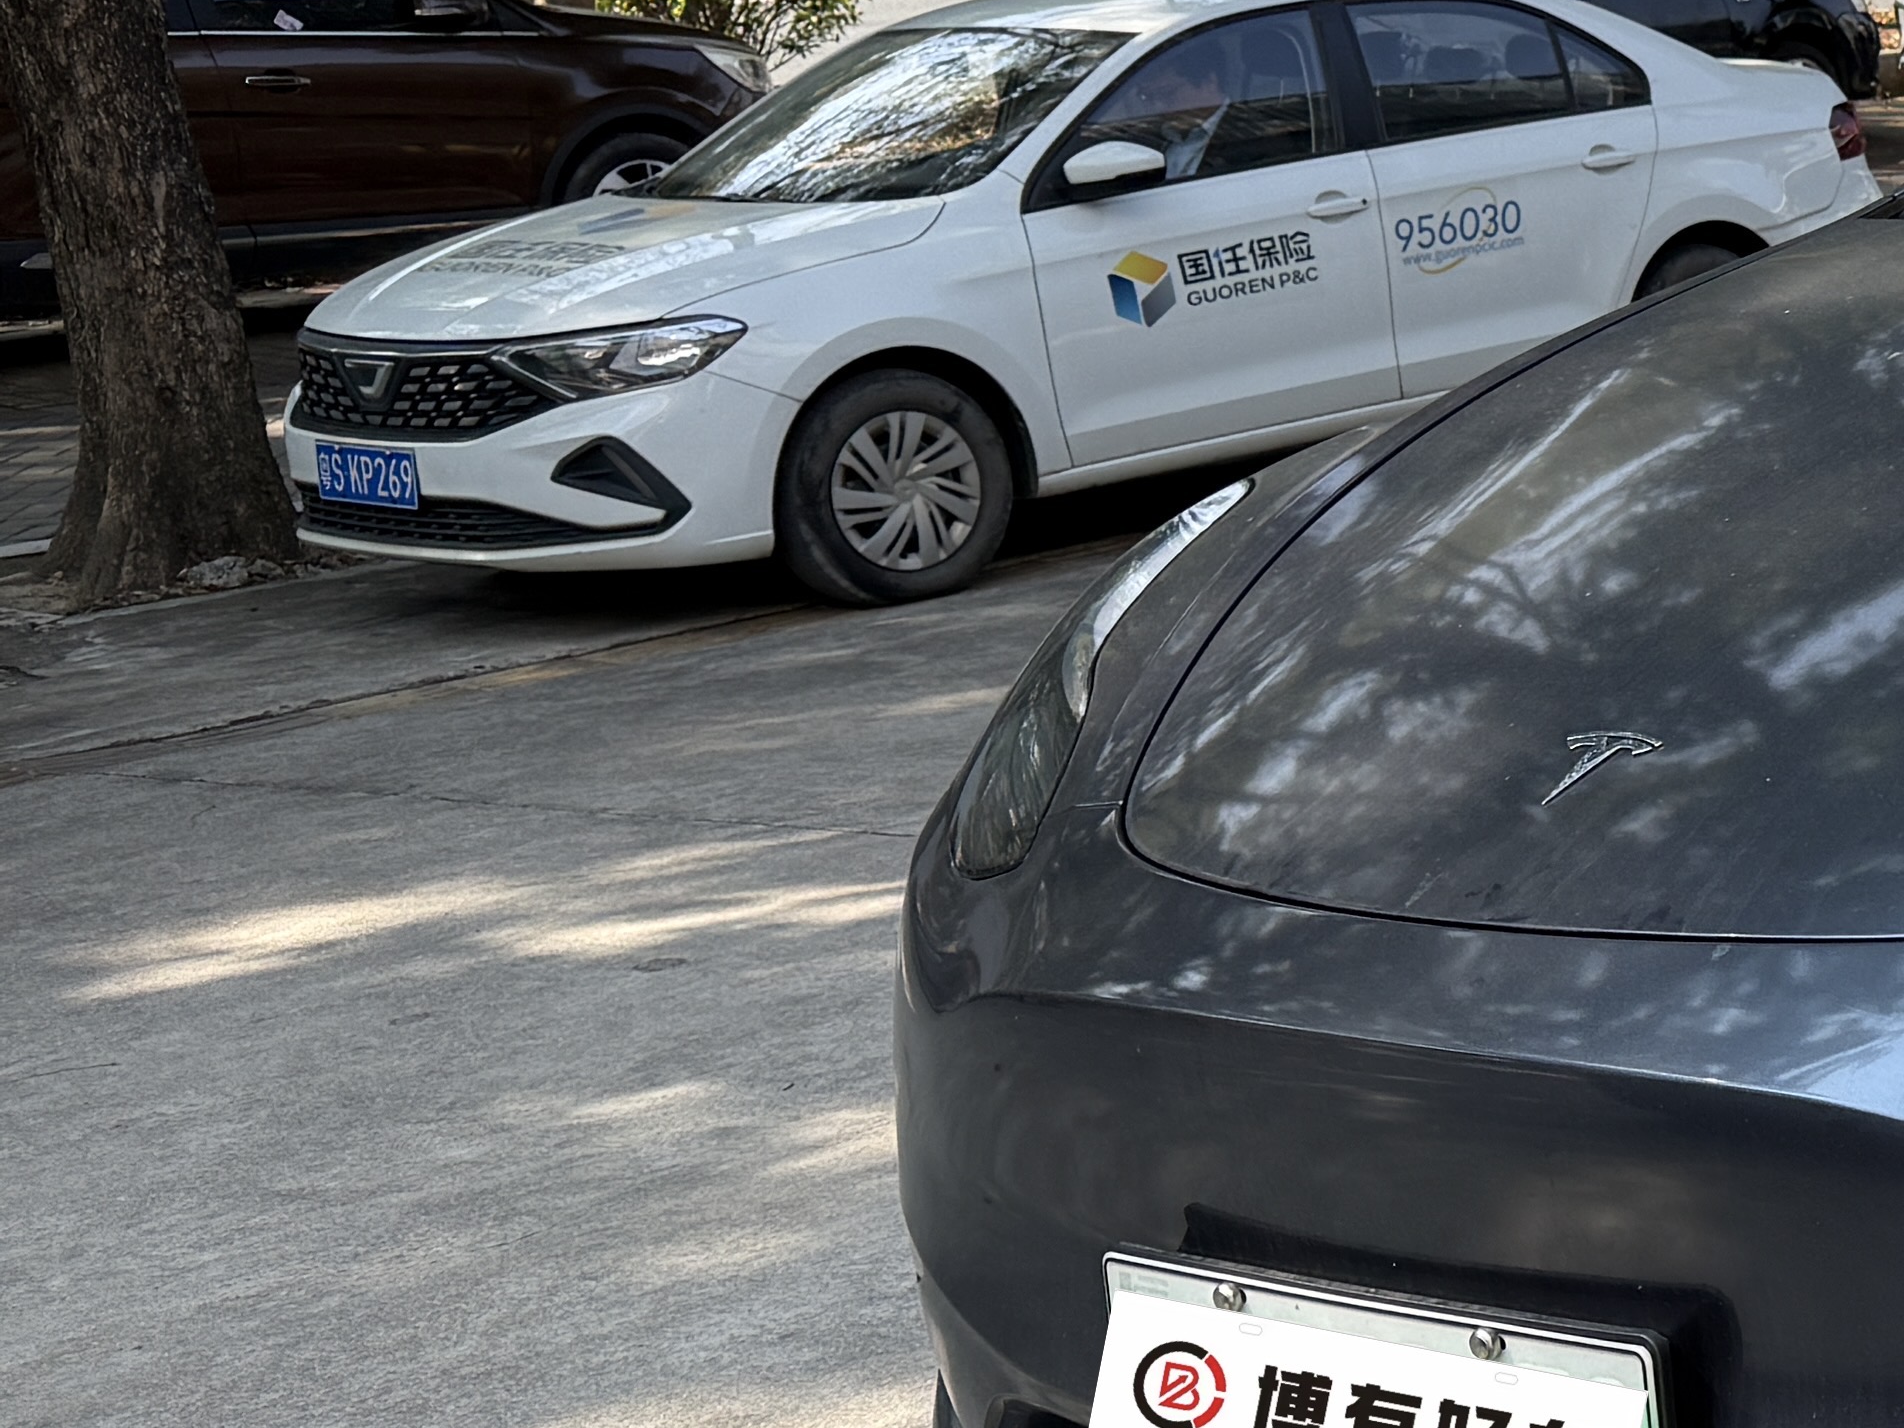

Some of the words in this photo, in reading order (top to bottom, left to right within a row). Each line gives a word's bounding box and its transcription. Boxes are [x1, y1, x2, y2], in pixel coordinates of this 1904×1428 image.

[1395, 200, 1521, 253] 956030
[1177, 231, 1316, 285] 国任保险
[1187, 276, 1276, 306] GUOREN
[1279, 267, 1319, 289] P&C
